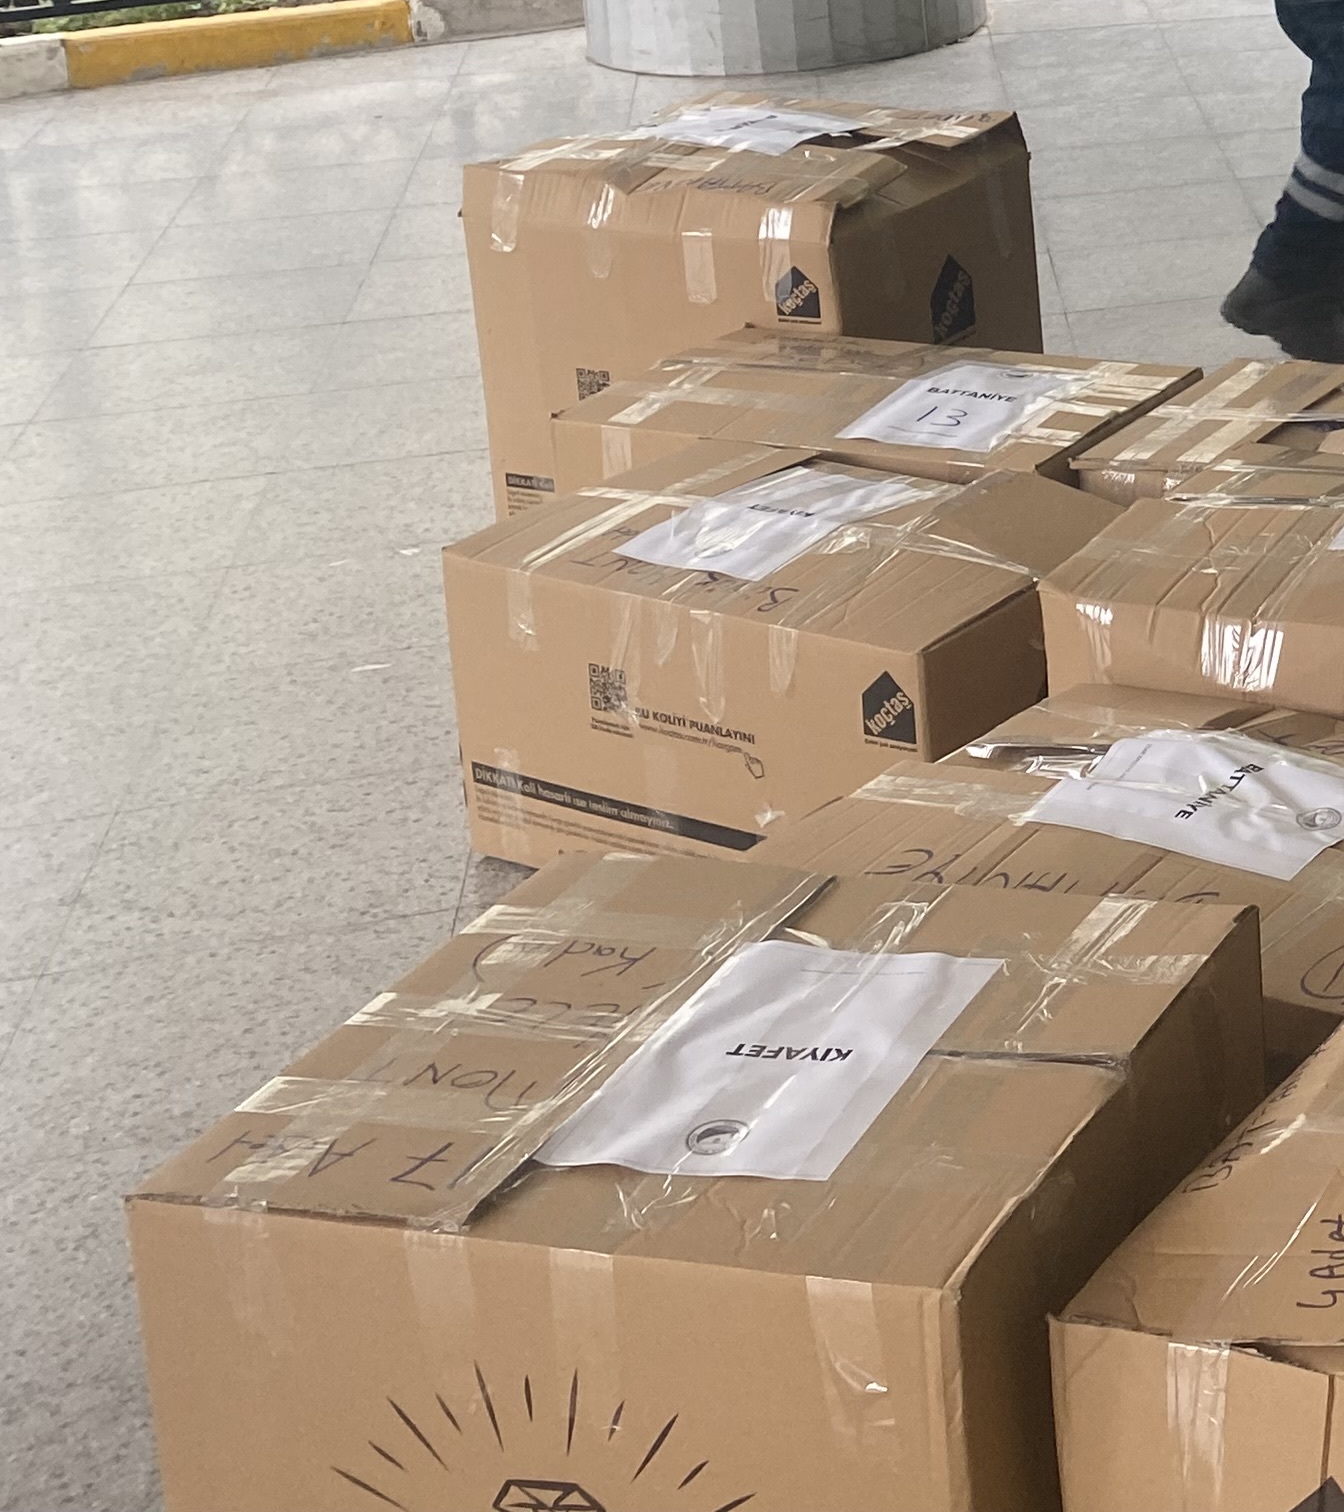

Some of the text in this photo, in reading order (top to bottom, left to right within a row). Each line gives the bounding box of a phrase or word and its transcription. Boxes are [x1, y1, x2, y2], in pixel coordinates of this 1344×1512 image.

[927, 387, 1018, 403] BATTANİYE
[916, 405, 968, 427] 13
[864, 691, 913, 736] koçtaş
[1174, 762, 1267, 821] BATTANİYE
[726, 1040, 854, 1062] KIYAFET
